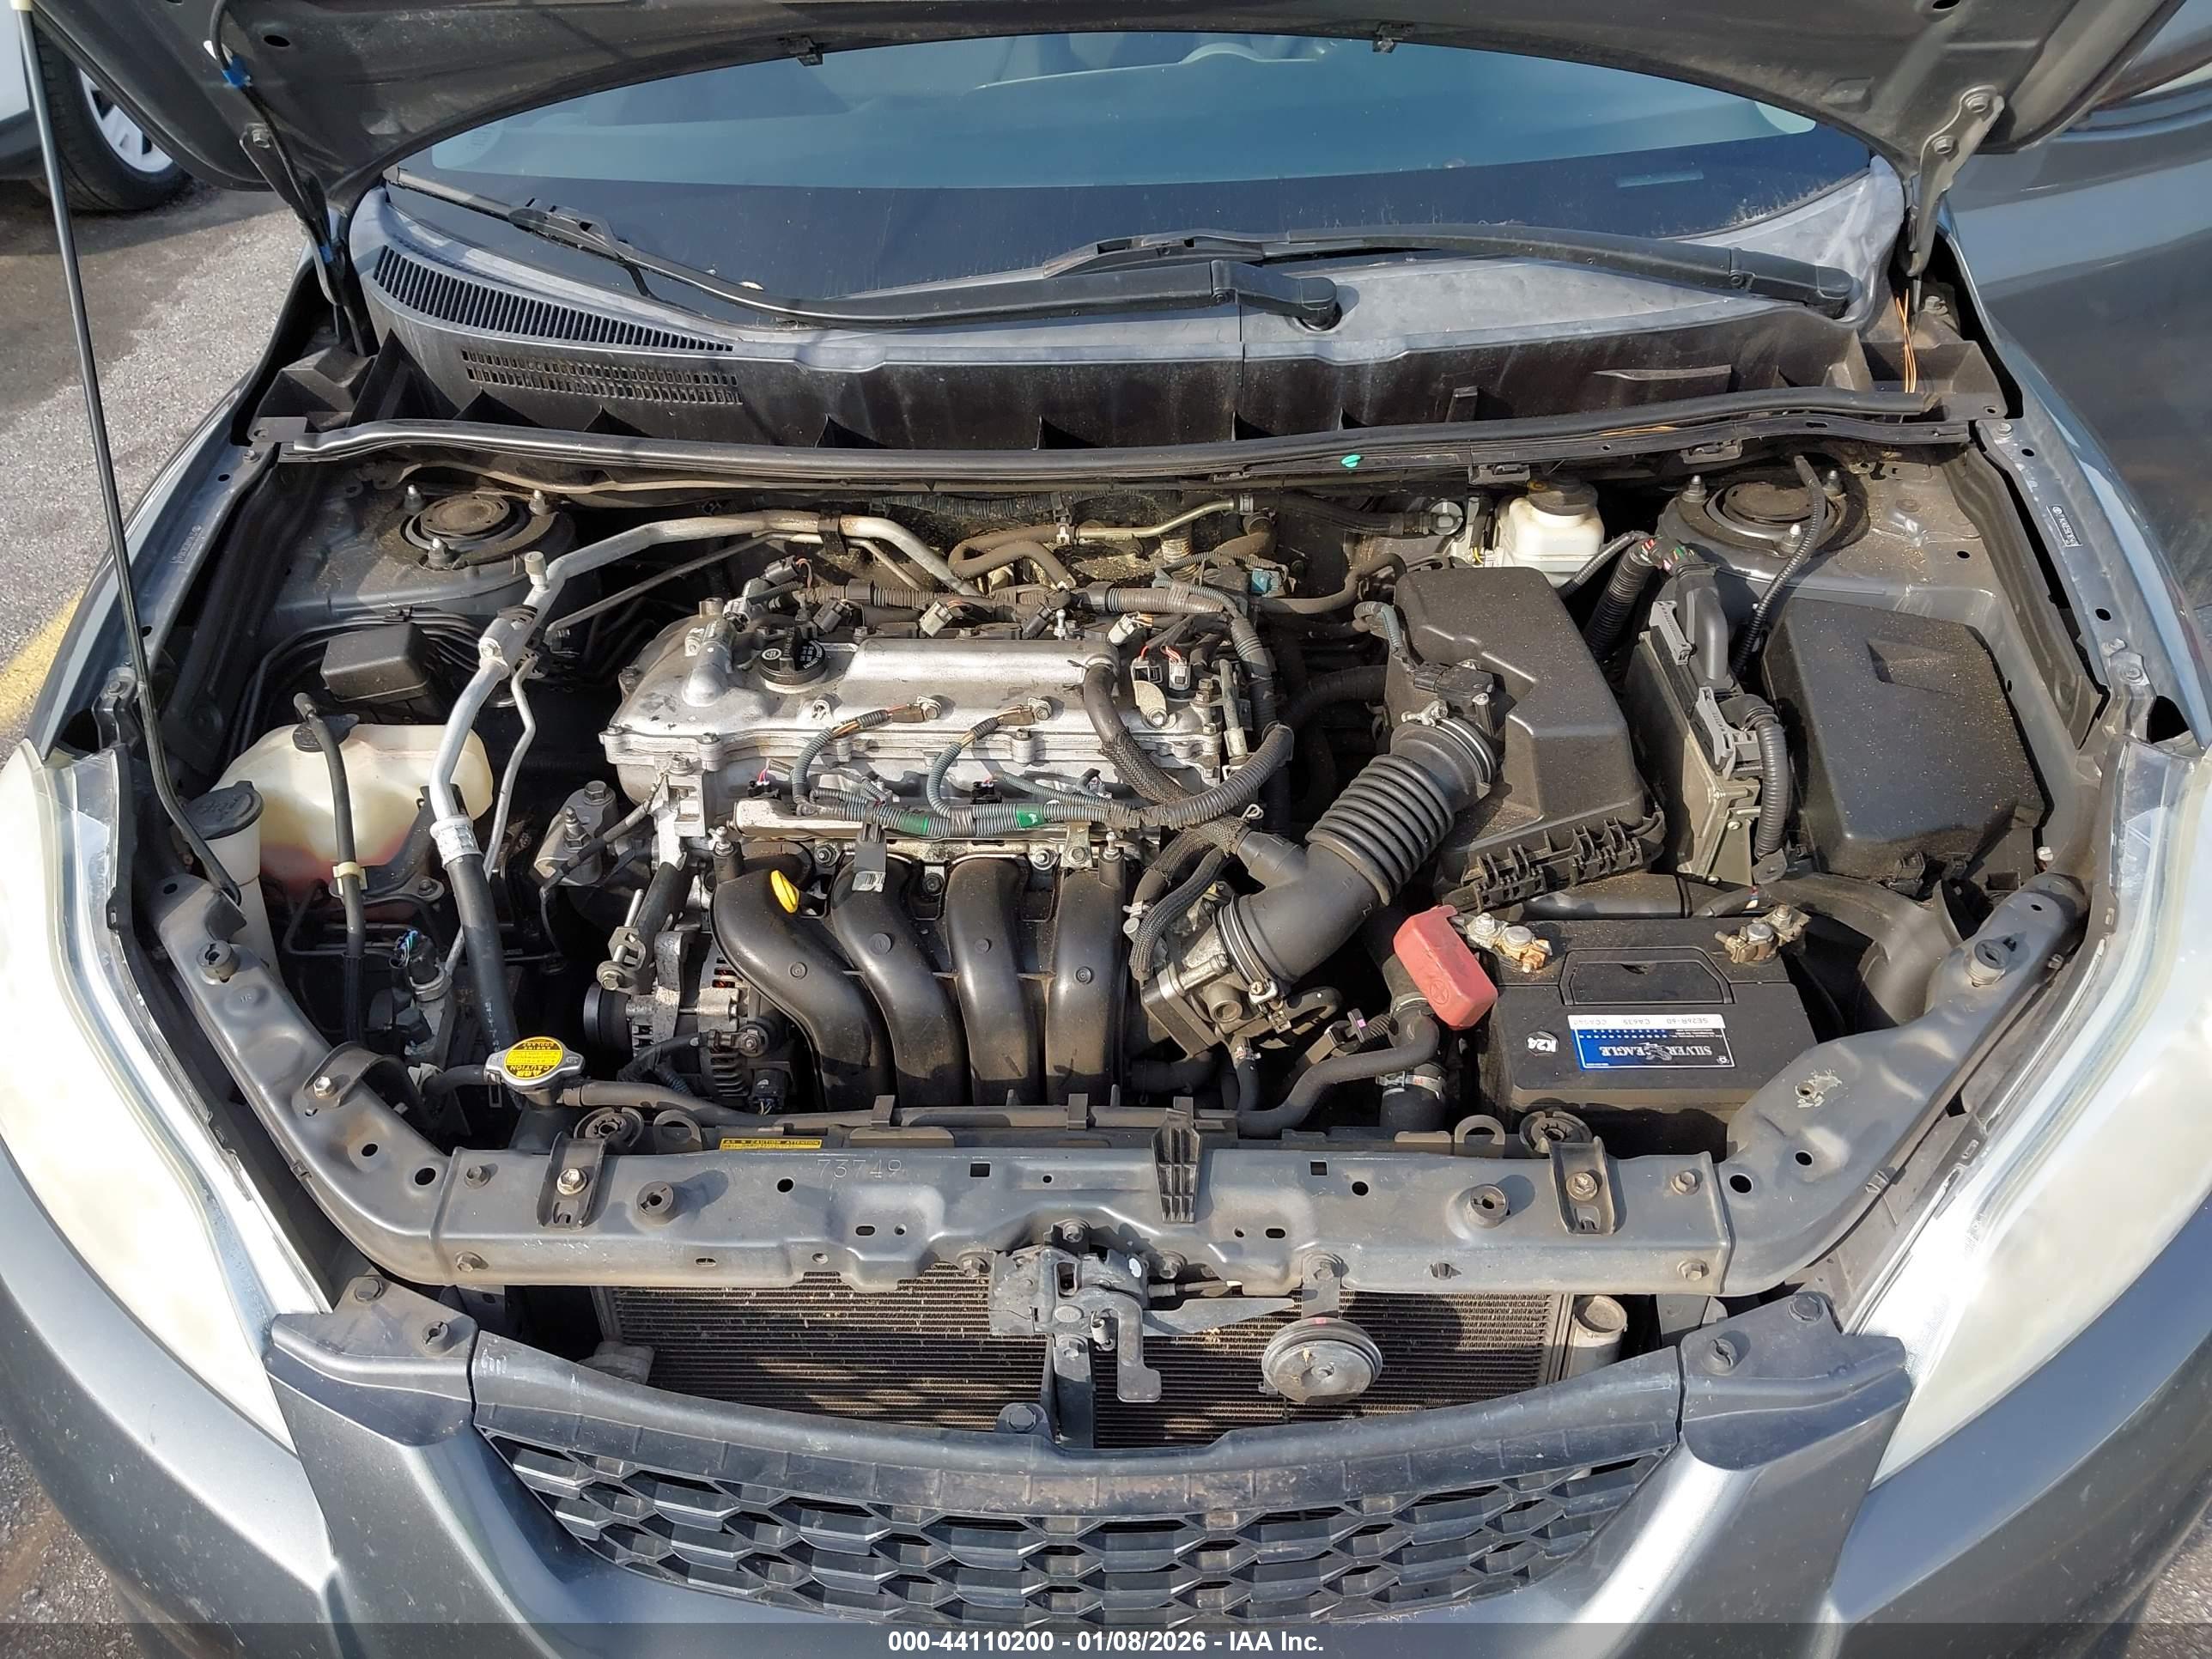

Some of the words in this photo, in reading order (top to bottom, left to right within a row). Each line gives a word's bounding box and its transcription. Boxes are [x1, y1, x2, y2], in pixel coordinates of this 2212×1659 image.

[1528, 1036, 1557, 1053] K24
[1600, 1046, 1646, 1056] EAGLE
[1666, 1045, 1712, 1056] SILVER
[817, 1158, 902, 1179] 73749
